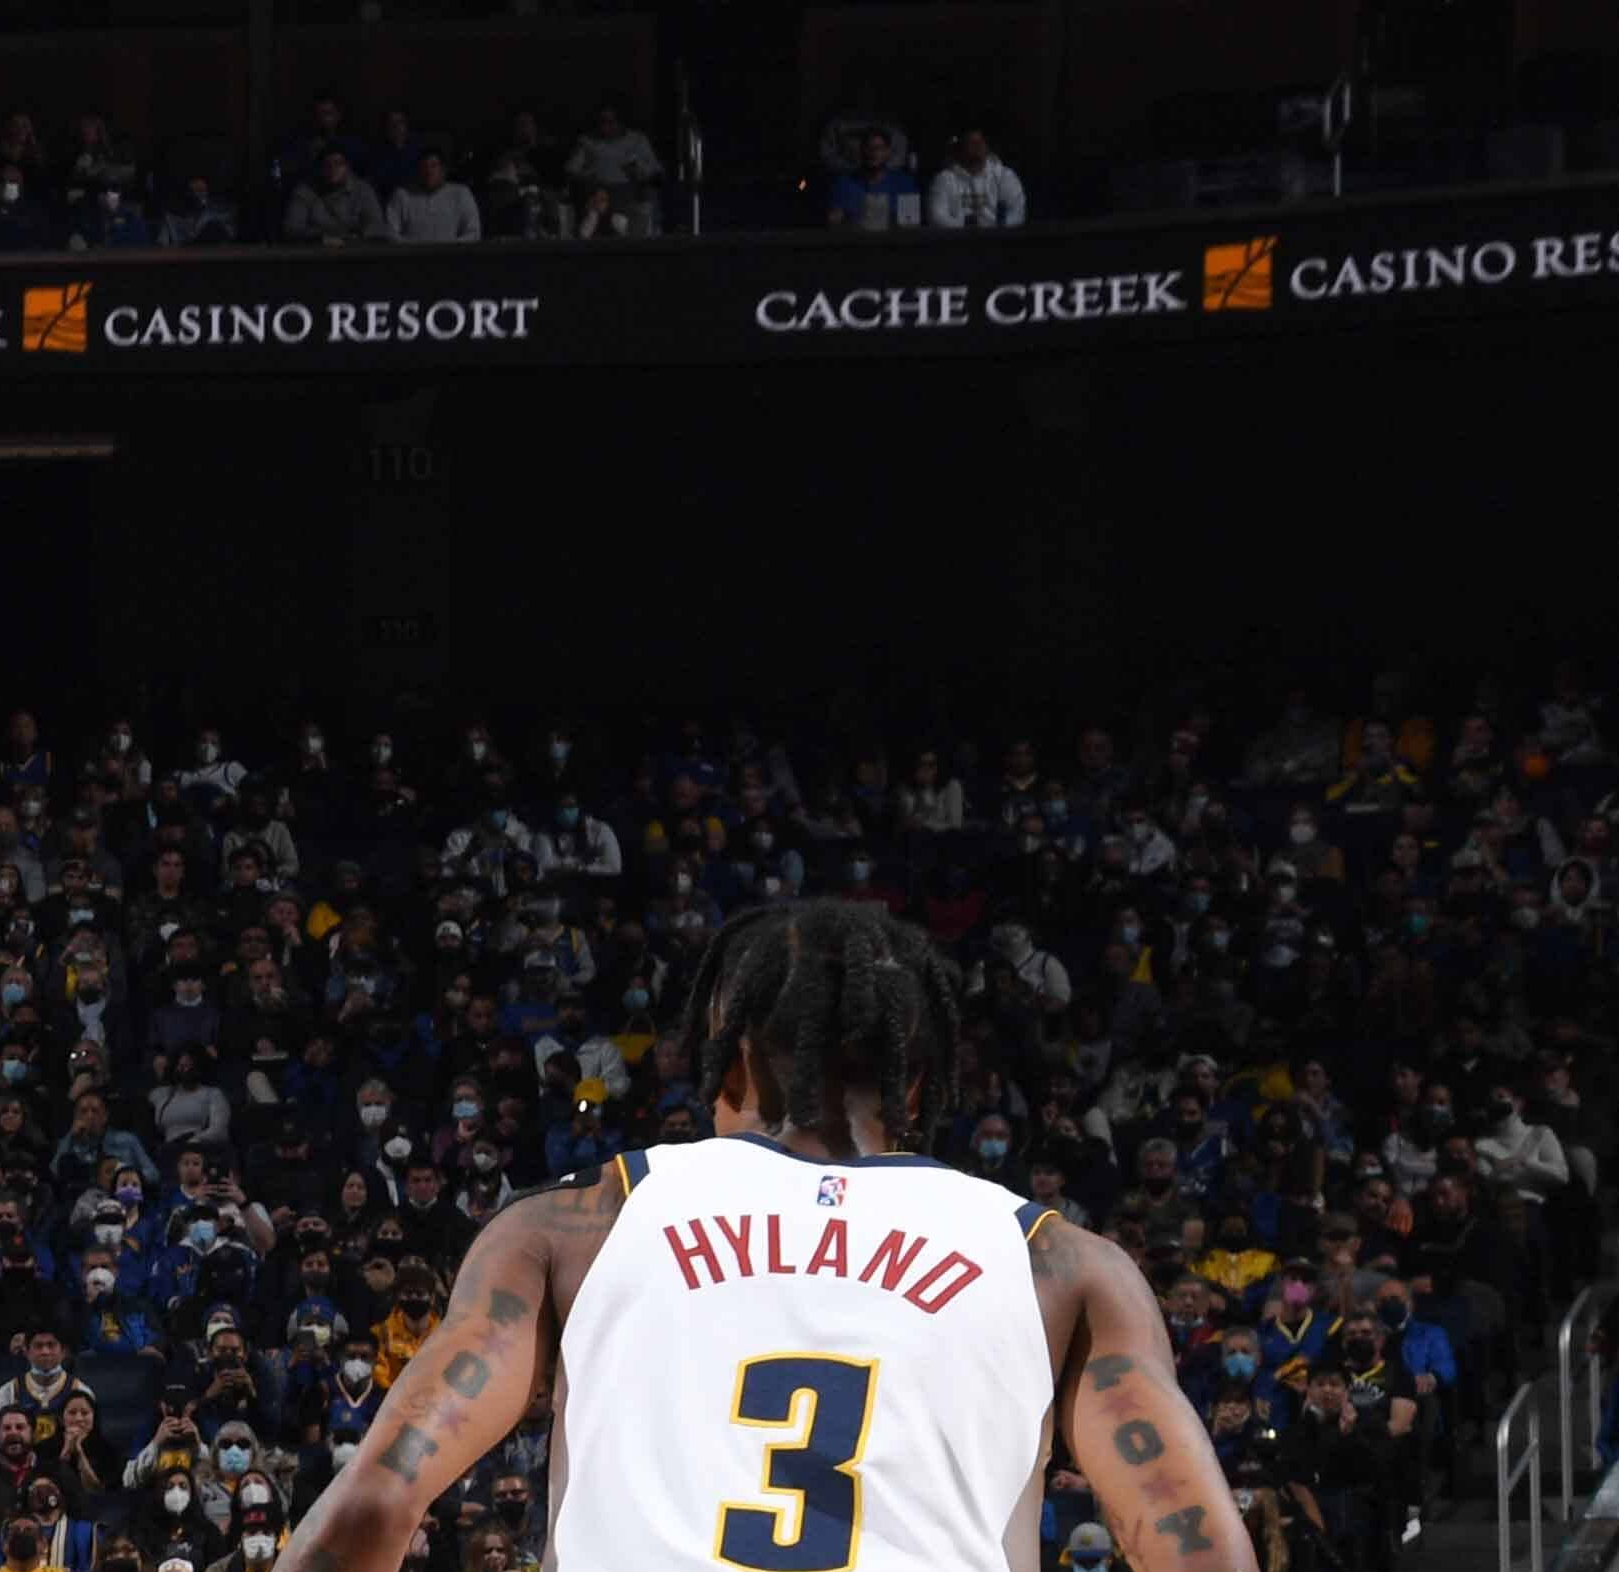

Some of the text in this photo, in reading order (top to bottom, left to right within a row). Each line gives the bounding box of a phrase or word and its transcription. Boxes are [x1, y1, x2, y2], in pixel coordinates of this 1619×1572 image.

[755, 287, 969, 331] CACHE
[984, 272, 1182, 323] CREEK
[1289, 243, 1517, 298] CASINO
[103, 304, 314, 346] CASINO
[327, 298, 540, 341] RESORT
[368, 448, 432, 481] 110
[662, 1213, 984, 1315] HYLAND
